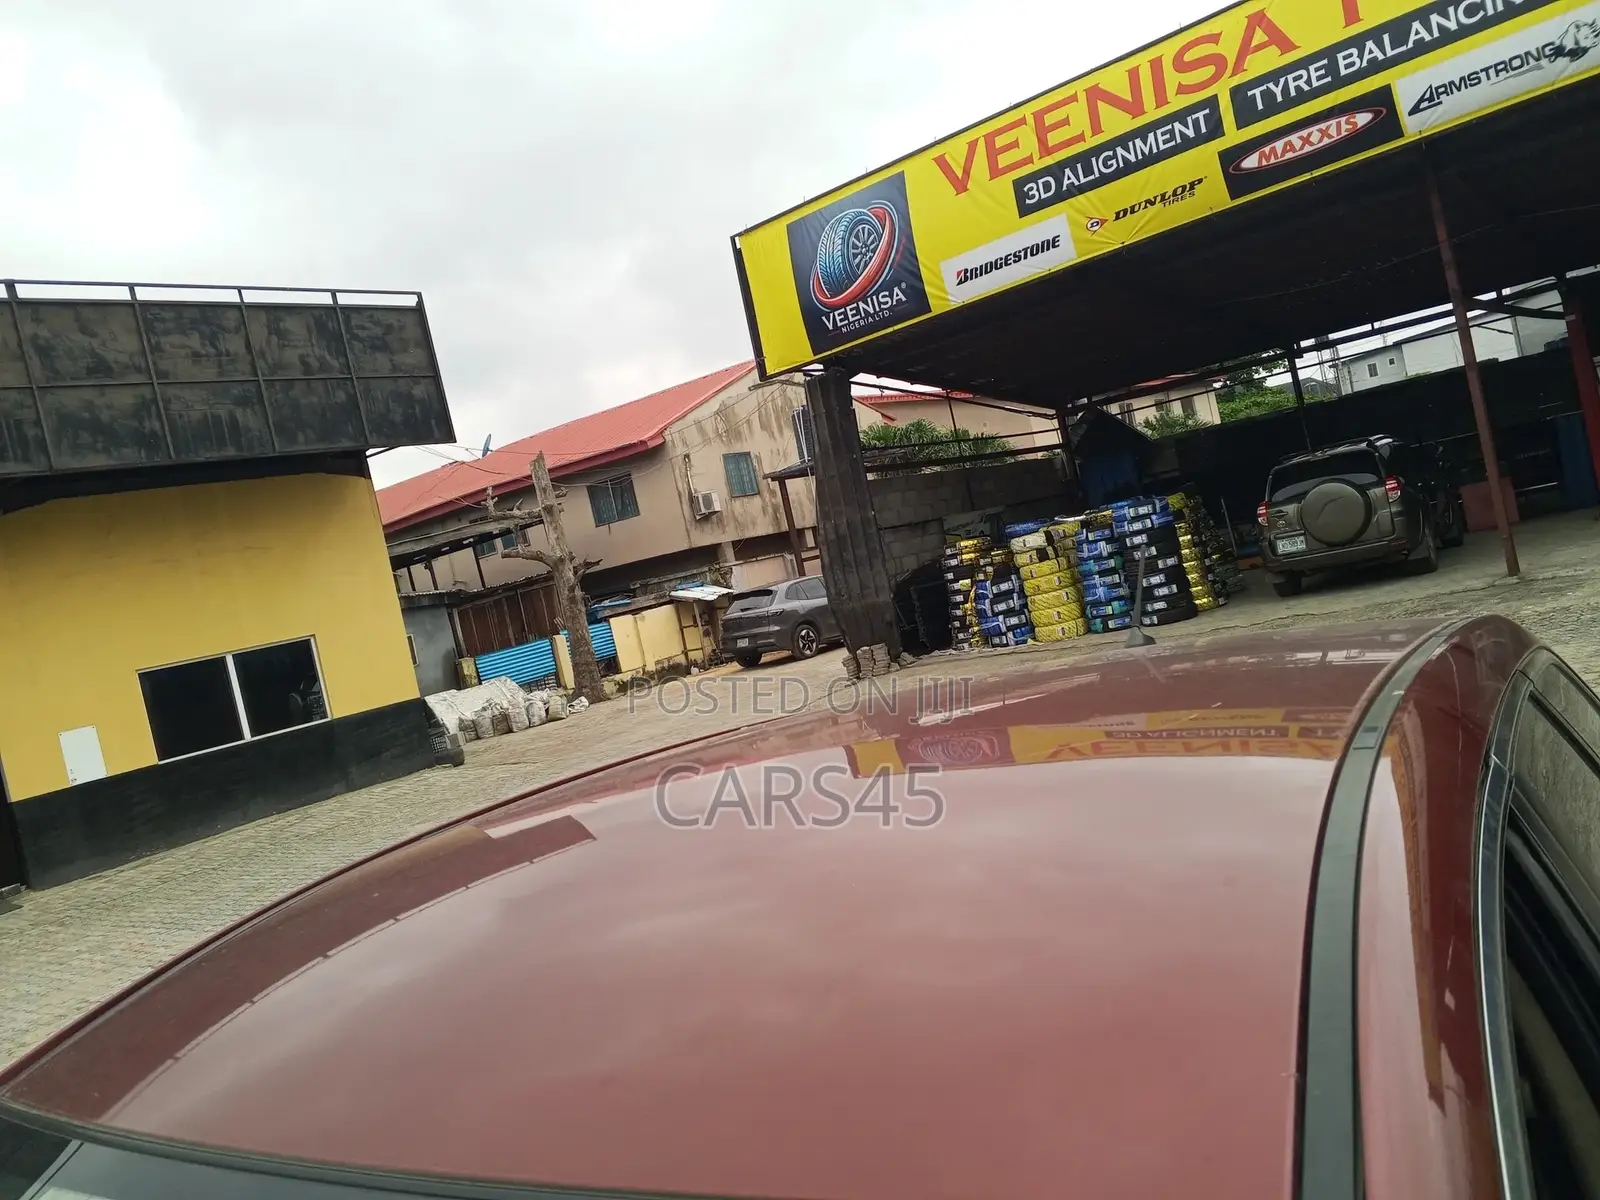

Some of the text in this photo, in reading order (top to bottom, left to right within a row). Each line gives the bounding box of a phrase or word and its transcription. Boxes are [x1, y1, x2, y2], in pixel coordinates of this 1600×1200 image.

[932, 8, 1302, 196] VEENISA
[1247, 58, 1332, 112] TYRE
[1022, 107, 1211, 205] 3D ALIGNMENT
[1256, 113, 1360, 169] MAXXIS
[1112, 177, 1206, 222] DUNLOP
[1162, 191, 1197, 209] TIRES
[955, 234, 1061, 287] BRIDGESTONE
[841, 310, 893, 334] NIGERIA LTD.
